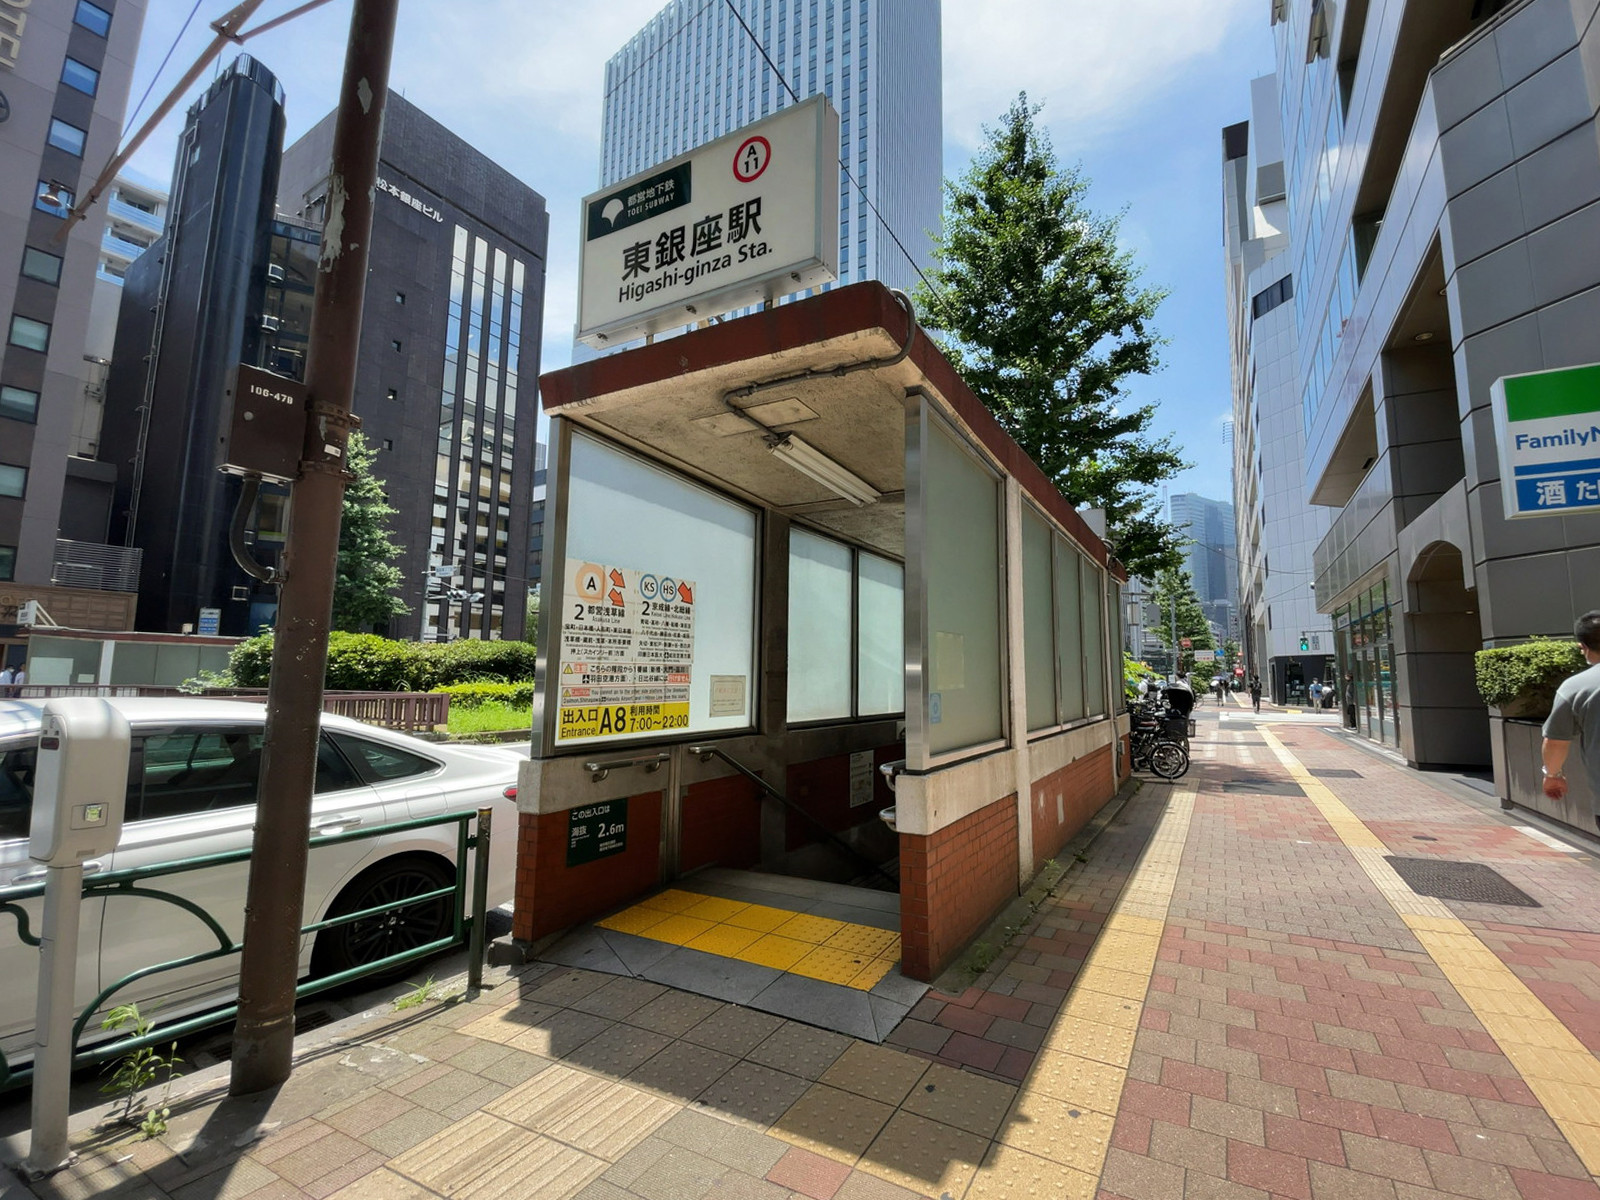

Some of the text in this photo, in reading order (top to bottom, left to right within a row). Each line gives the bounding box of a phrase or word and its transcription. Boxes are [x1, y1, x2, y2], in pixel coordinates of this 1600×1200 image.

[747, 144, 757, 159] A
[744, 157, 759, 173] 11
[627, 179, 675, 208] 都営地下鉄
[627, 192, 675, 218] TOEI SUBWAY
[621, 196, 762, 282] 東銀座駅
[619, 241, 773, 303] Higashi-ginza Sta.
[1536, 479, 1600, 506] 酒 た
[586, 576, 596, 591] A
[644, 582, 655, 592] KS
[663, 584, 674, 595] HS
[574, 603, 584, 621] 2
[642, 600, 650, 616] 2
[563, 705, 660, 734] 出入口 A8 利用時間
[561, 727, 596, 738] Entrance
[598, 823, 624, 838] 2.6m
